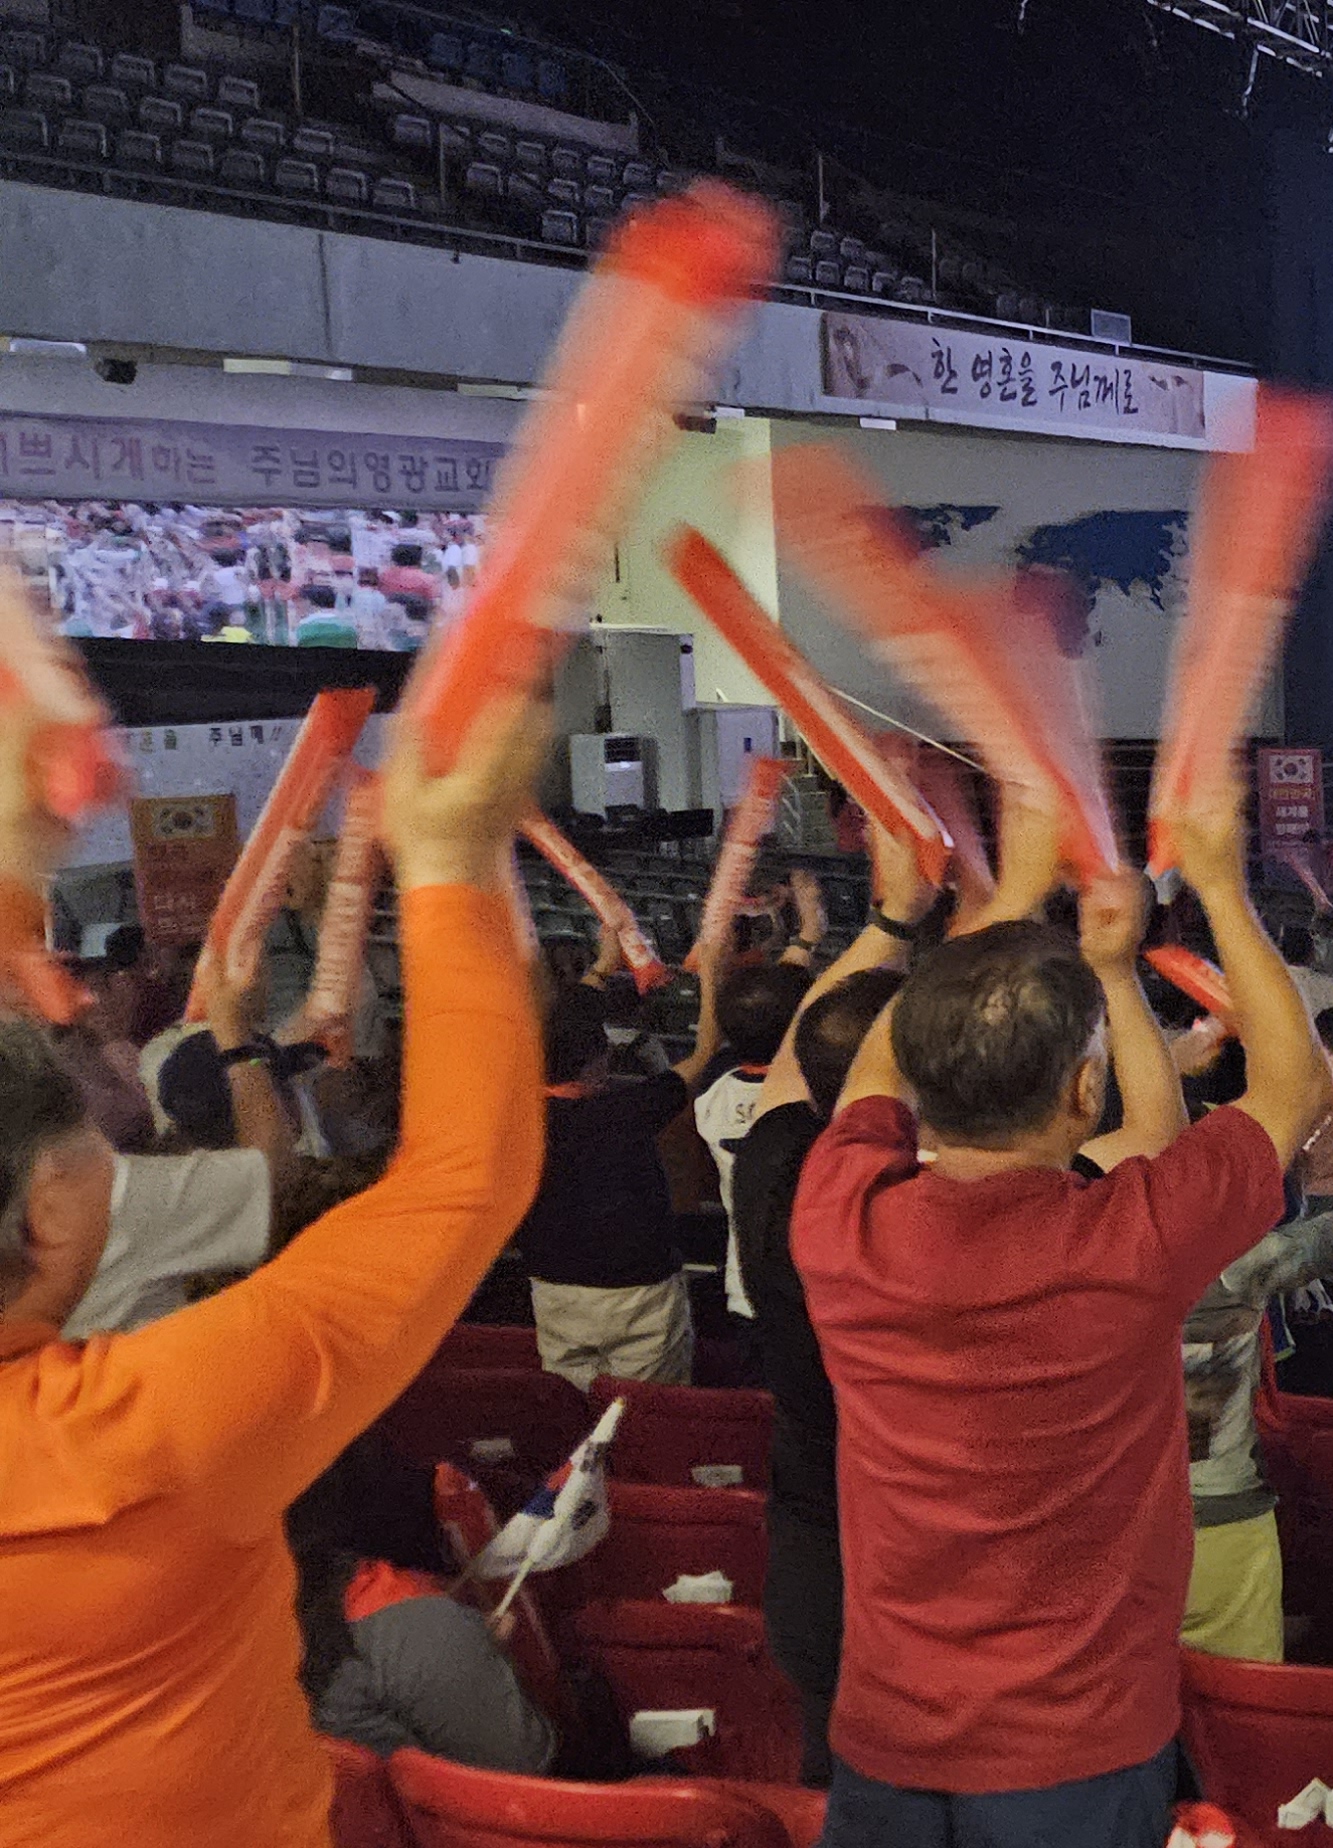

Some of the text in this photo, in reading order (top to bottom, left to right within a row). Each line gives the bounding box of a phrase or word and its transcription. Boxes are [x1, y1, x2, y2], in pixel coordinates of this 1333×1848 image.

[930, 337, 1140, 415] 한 영혼을 주님께로
[250, 443, 494, 495] 주님의영광교회
